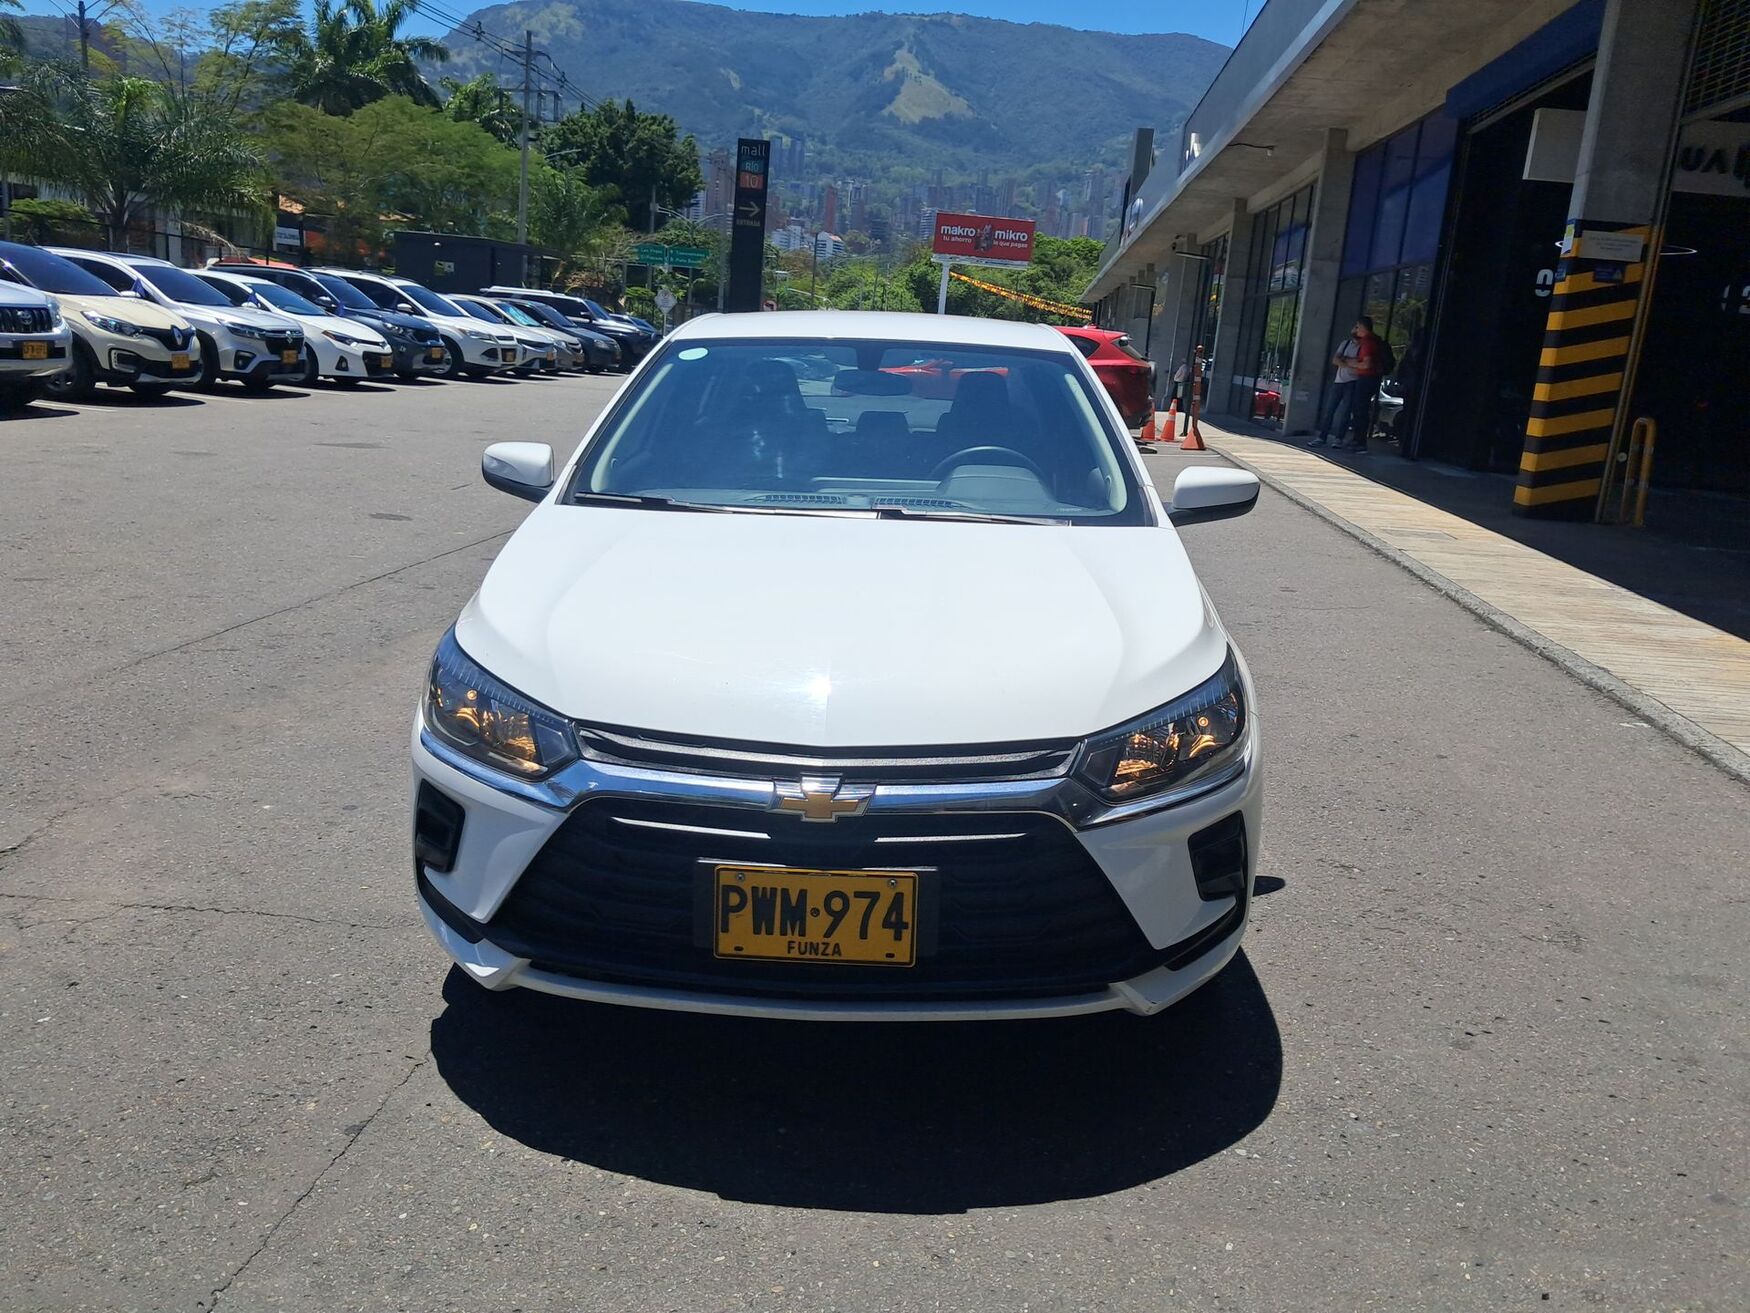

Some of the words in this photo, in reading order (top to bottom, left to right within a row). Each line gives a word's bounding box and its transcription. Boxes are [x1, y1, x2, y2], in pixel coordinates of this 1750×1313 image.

[742, 145, 765, 156] mall
[746, 174, 758, 189] 10
[940, 225, 976, 237] makro
[994, 230, 1028, 241] mikro
[720, 884, 808, 938] PWM
[823, 890, 909, 942] 974
[787, 940, 842, 957] FUNZA
